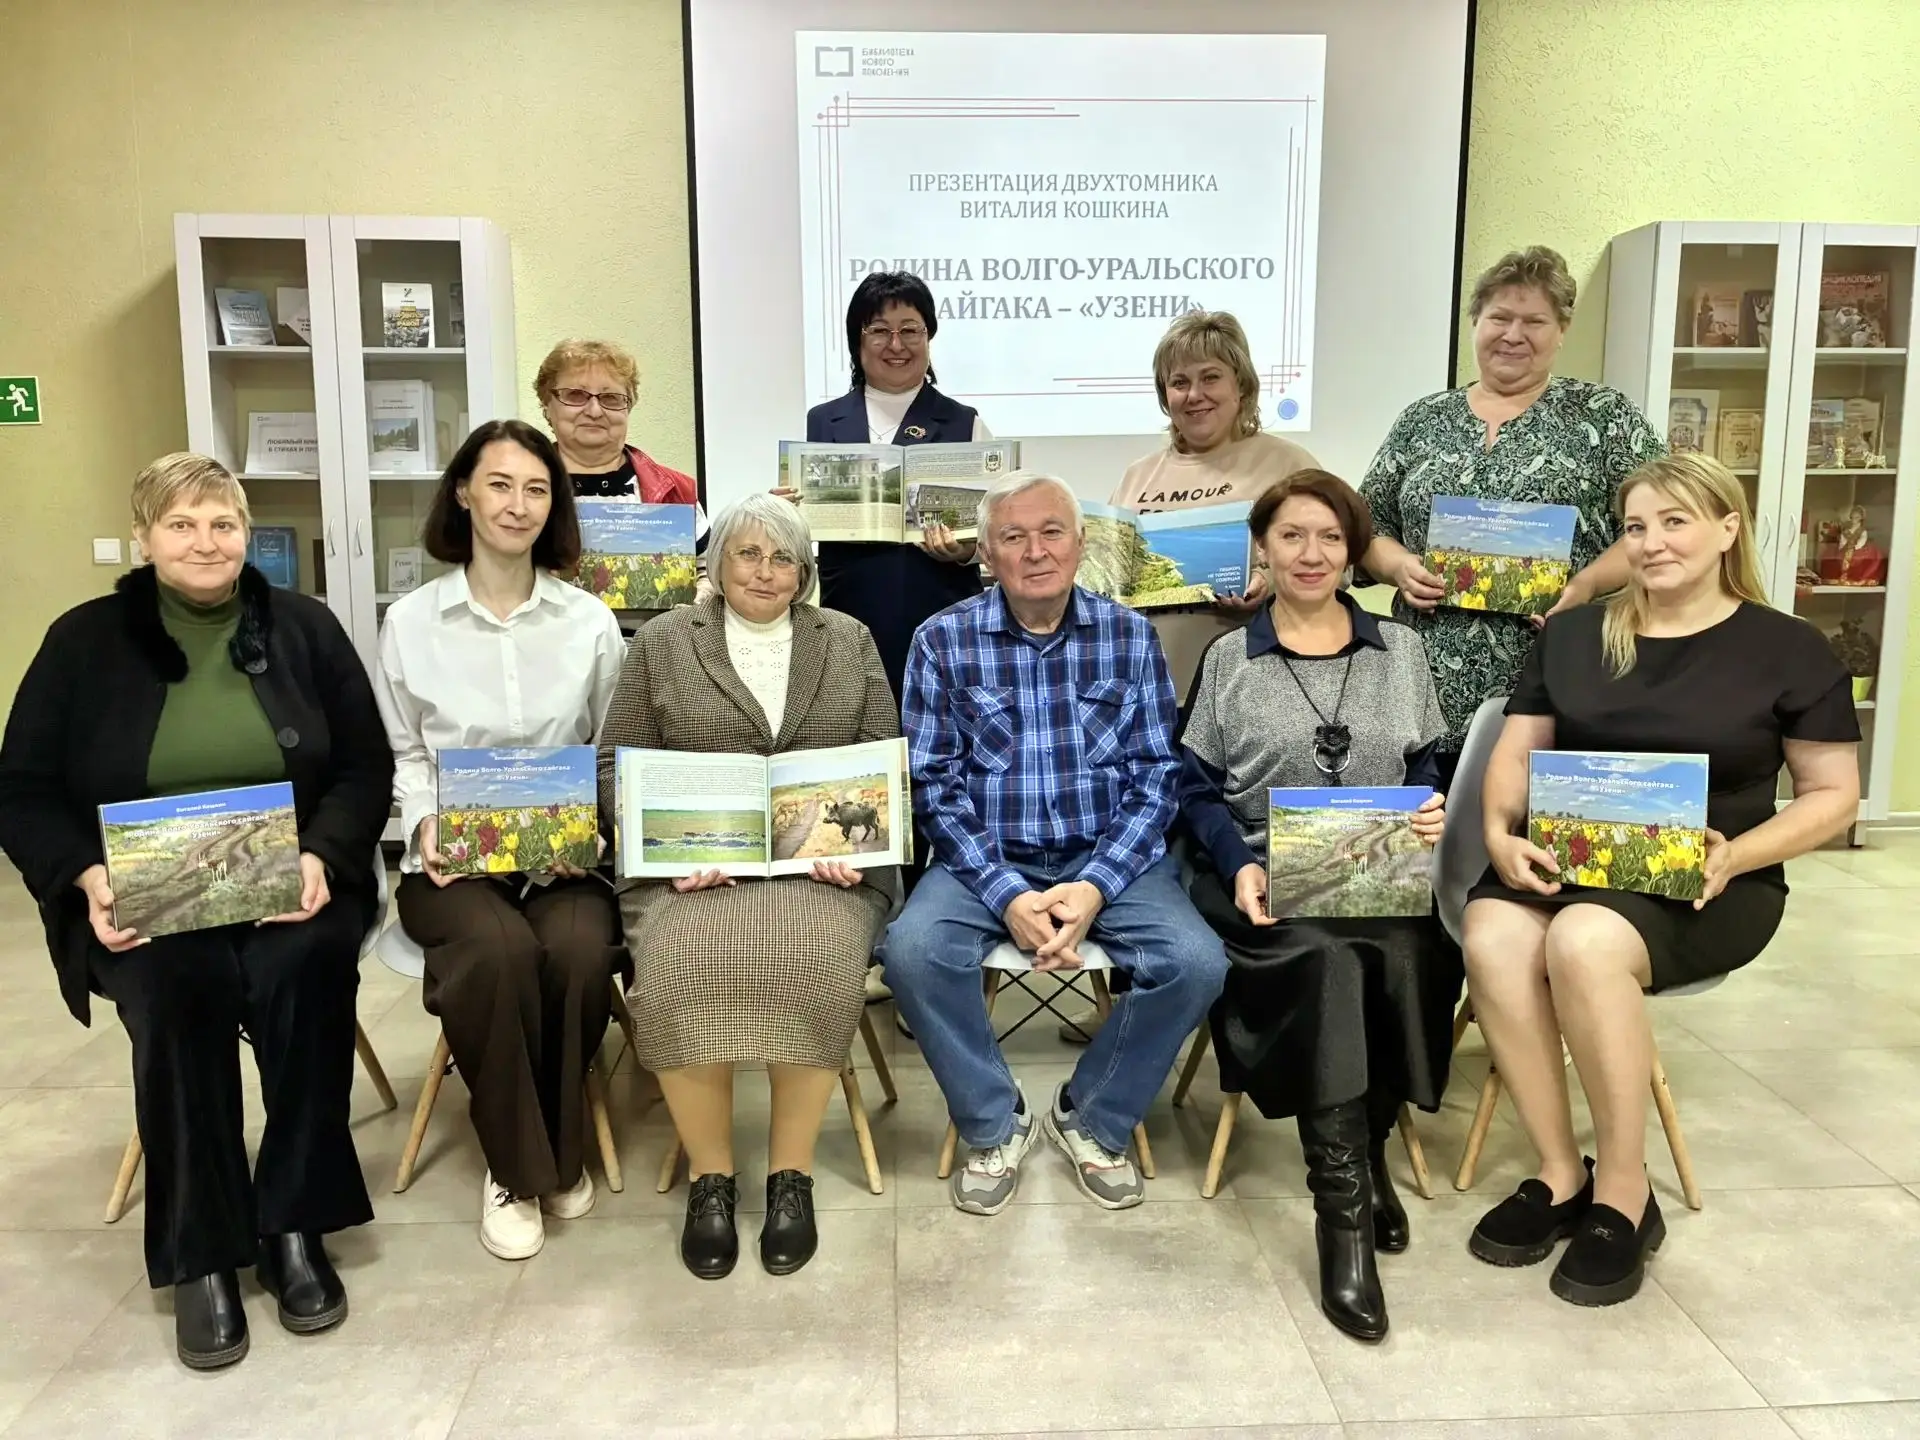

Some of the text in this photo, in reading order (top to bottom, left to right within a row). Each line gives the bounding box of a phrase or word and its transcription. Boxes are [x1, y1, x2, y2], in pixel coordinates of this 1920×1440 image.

[908, 173, 1220, 196] ПРЕЗЕНТАЦИЯ ДВУХТОМНИКА
[959, 200, 1170, 219] ВИТАЛИЯ КОШКИНА
[981, 256, 1275, 282] ВОЛГО-УРАЛЬСКОГО
[936, 289, 1053, 320] АЙГАКА
